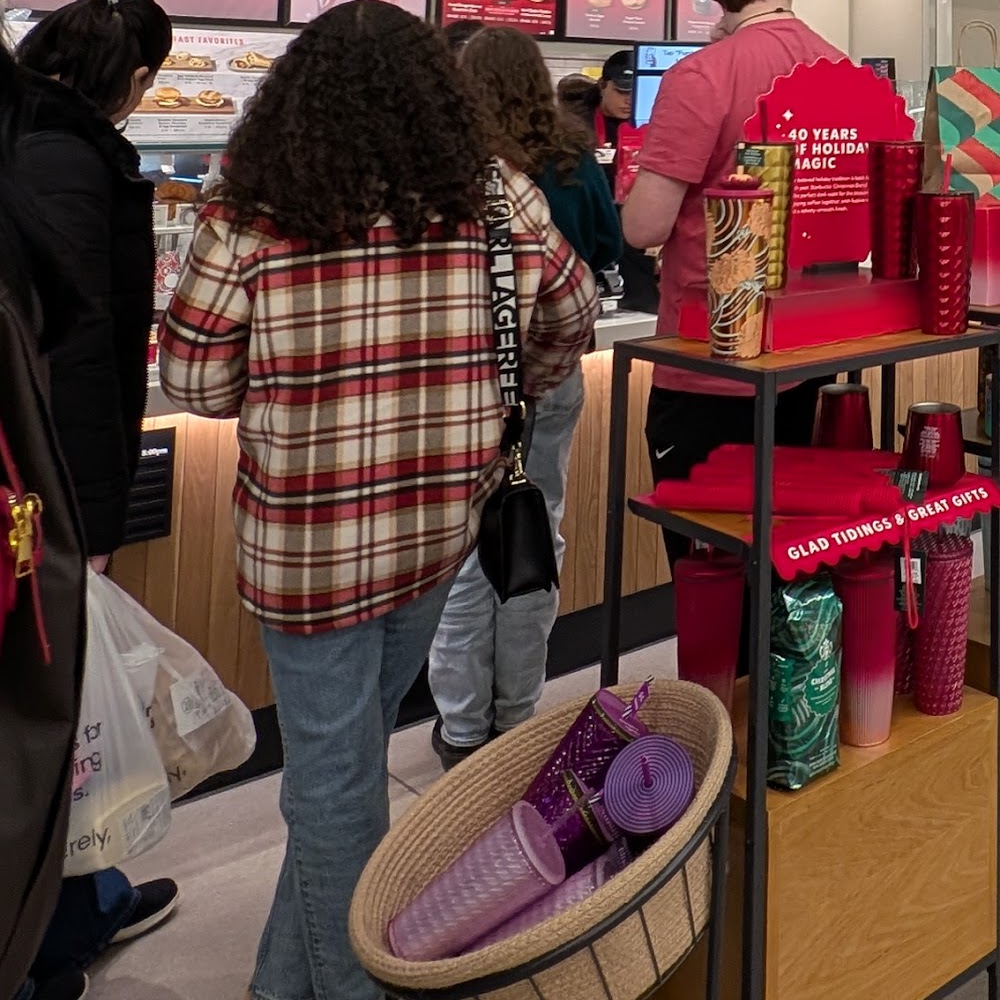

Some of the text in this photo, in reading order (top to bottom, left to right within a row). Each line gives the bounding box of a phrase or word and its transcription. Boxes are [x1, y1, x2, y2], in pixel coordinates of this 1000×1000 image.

[198, 36, 245, 46] FAVORITES
[787, 128, 858, 141] 40 YEARS
[490, 273, 521, 408] LAGERFE
[787, 487, 989, 560] GLAD TIDINGS & GREAT GIFTS
[83, 722, 102, 743] for
[65, 827, 112, 857] rely,
